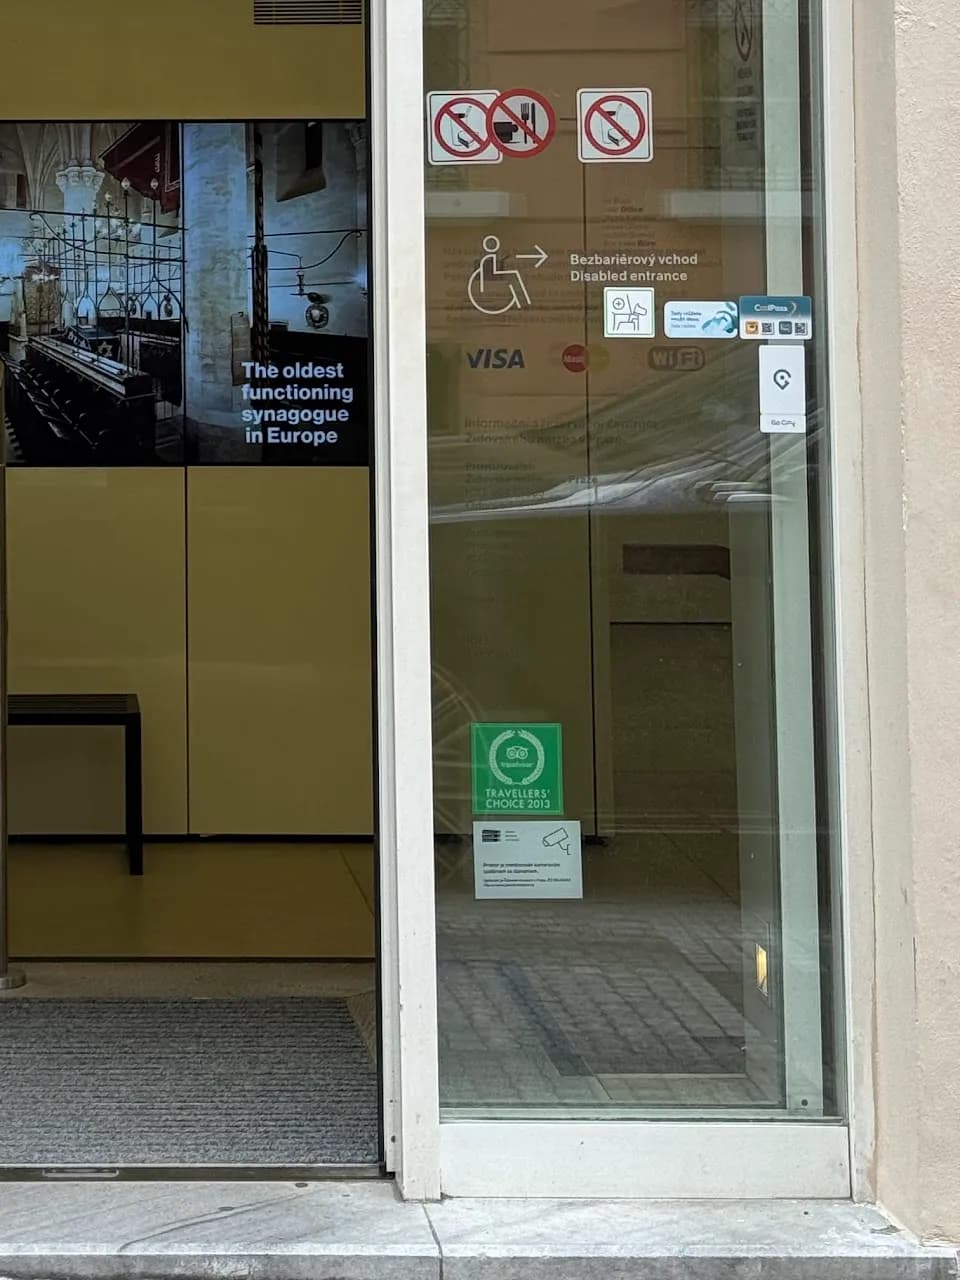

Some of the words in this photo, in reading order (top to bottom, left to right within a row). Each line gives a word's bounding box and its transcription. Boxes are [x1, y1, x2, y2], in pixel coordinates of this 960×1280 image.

[658, 253, 698, 265] vchod
[570, 271, 627, 282] Disabled
[630, 271, 688, 282] entrance
[467, 348, 526, 369] VISA
[240, 361, 279, 379] The
[282, 361, 344, 379] oldest
[241, 383, 354, 403] functioning
[241, 409, 350, 425] synagogue
[245, 427, 263, 443] in
[267, 426, 338, 447] Europe
[486, 799, 525, 809] CHOICE
[527, 799, 551, 809] 2013
